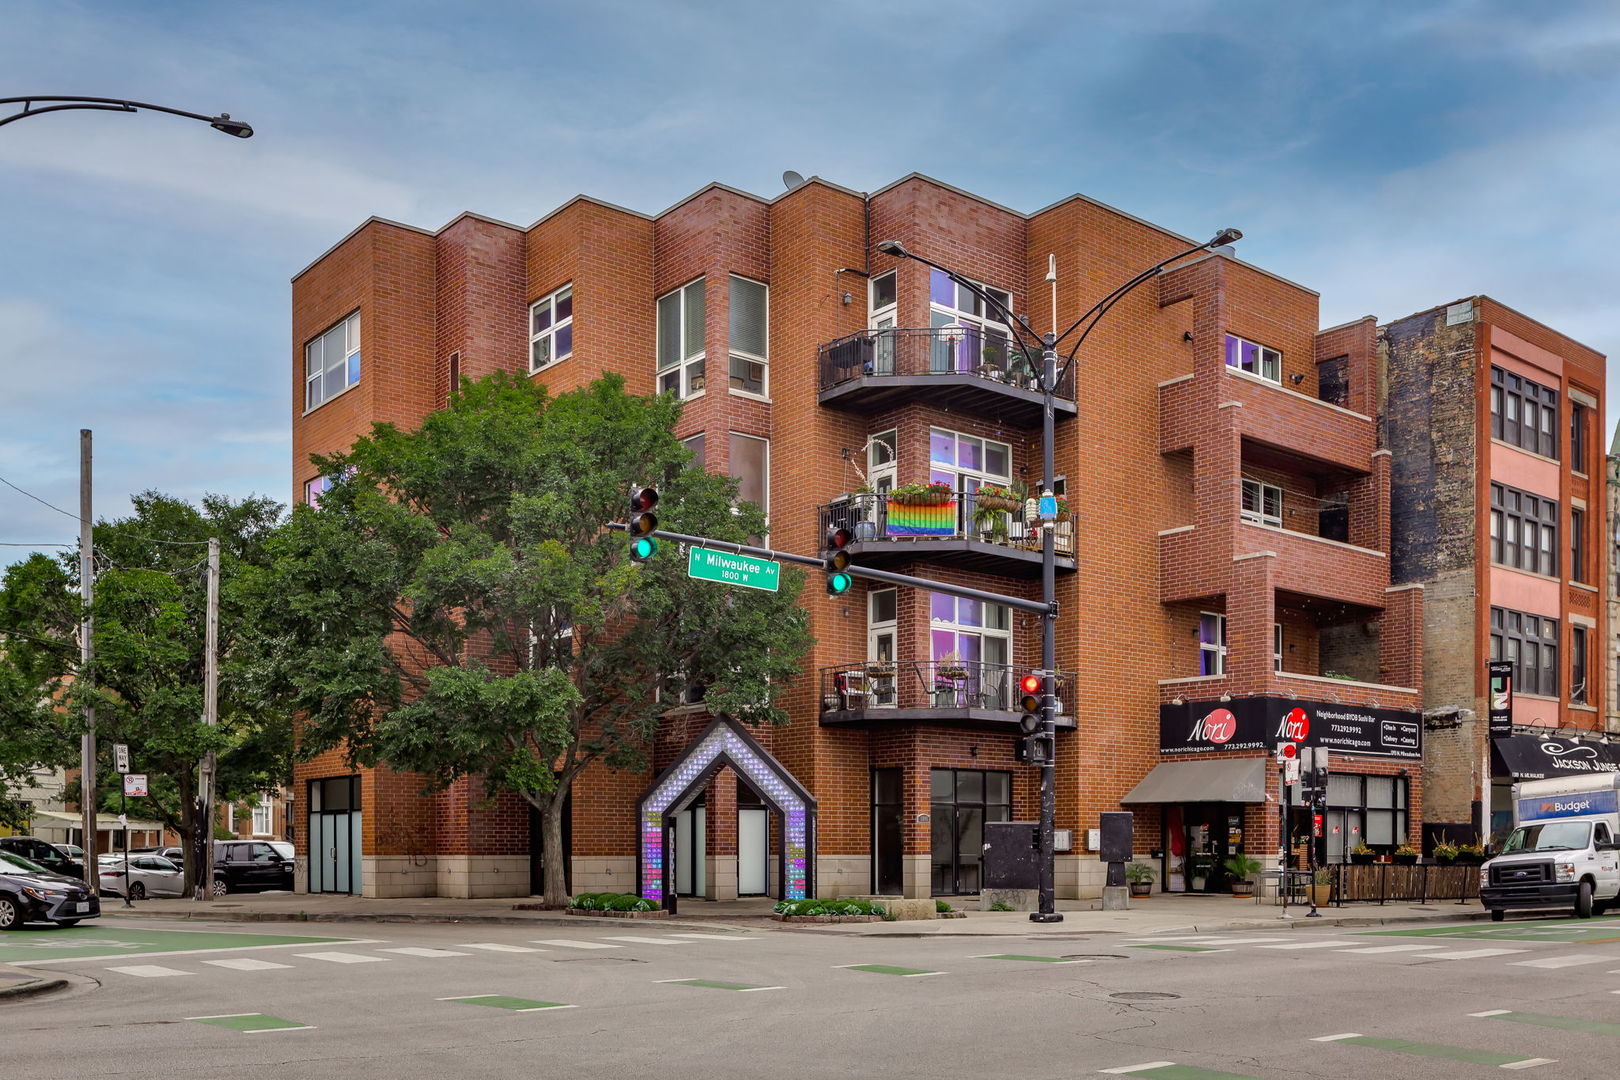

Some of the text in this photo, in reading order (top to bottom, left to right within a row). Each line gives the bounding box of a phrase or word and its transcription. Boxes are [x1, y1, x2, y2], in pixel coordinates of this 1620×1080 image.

[694, 553, 775, 575] N Milwaukee Av
[722, 570, 748, 582] 1800 W
[1316, 710, 1346, 721] Neighborhood
[1358, 714, 1368, 722] Sushi
[1186, 714, 1232, 742] Nori
[1275, 712, 1307, 740] Nori
[1224, 742, 1264, 750] 773.292.9992
[1320, 737, 1371, 748] www.norichicago.com
[1552, 756, 1619, 772] JACKSON JUNGE
[1554, 800, 1590, 812] Budget
